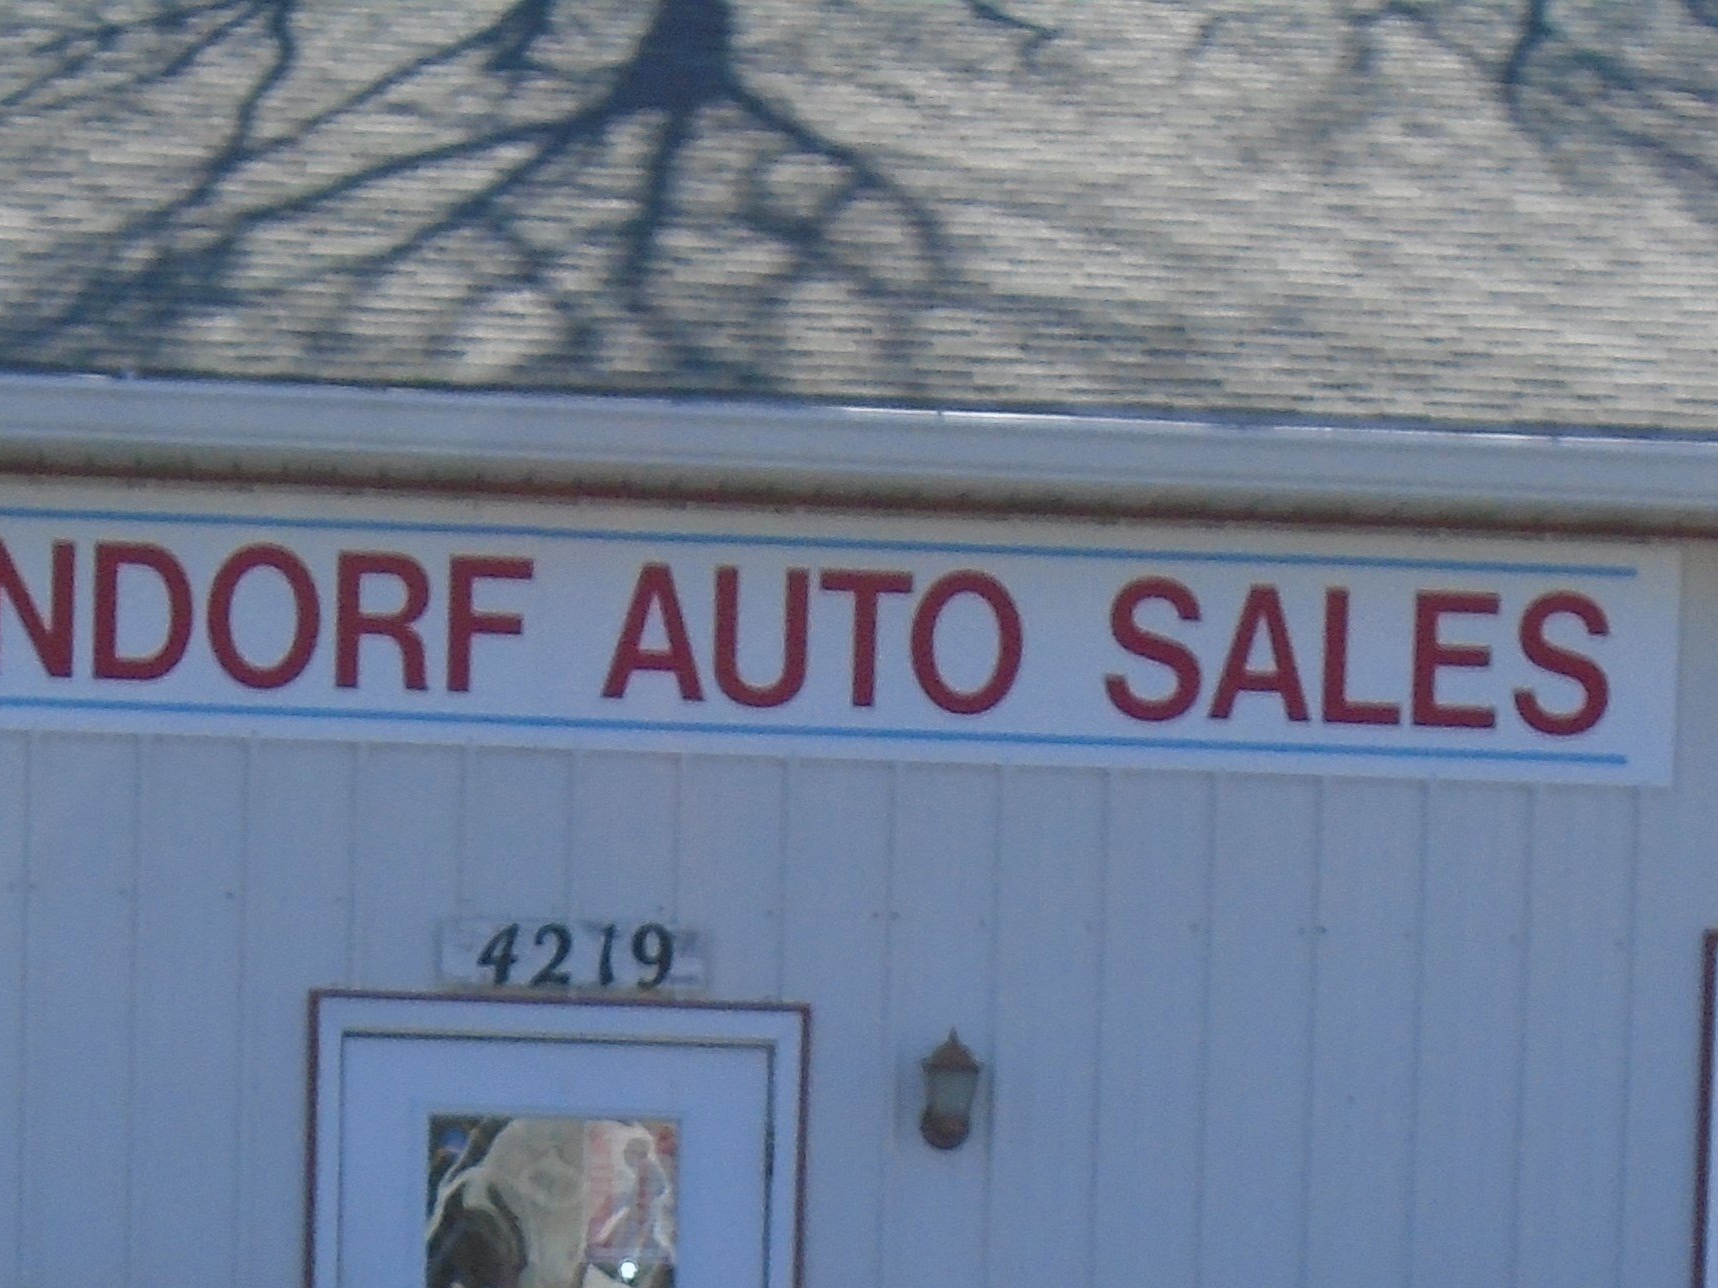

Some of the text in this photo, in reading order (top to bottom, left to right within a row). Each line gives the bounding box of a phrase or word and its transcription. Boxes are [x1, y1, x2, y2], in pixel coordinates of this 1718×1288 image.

[603, 561, 1025, 712] AUTO
[1107, 573, 1615, 736] SALES
[477, 922, 674, 988] 4219
